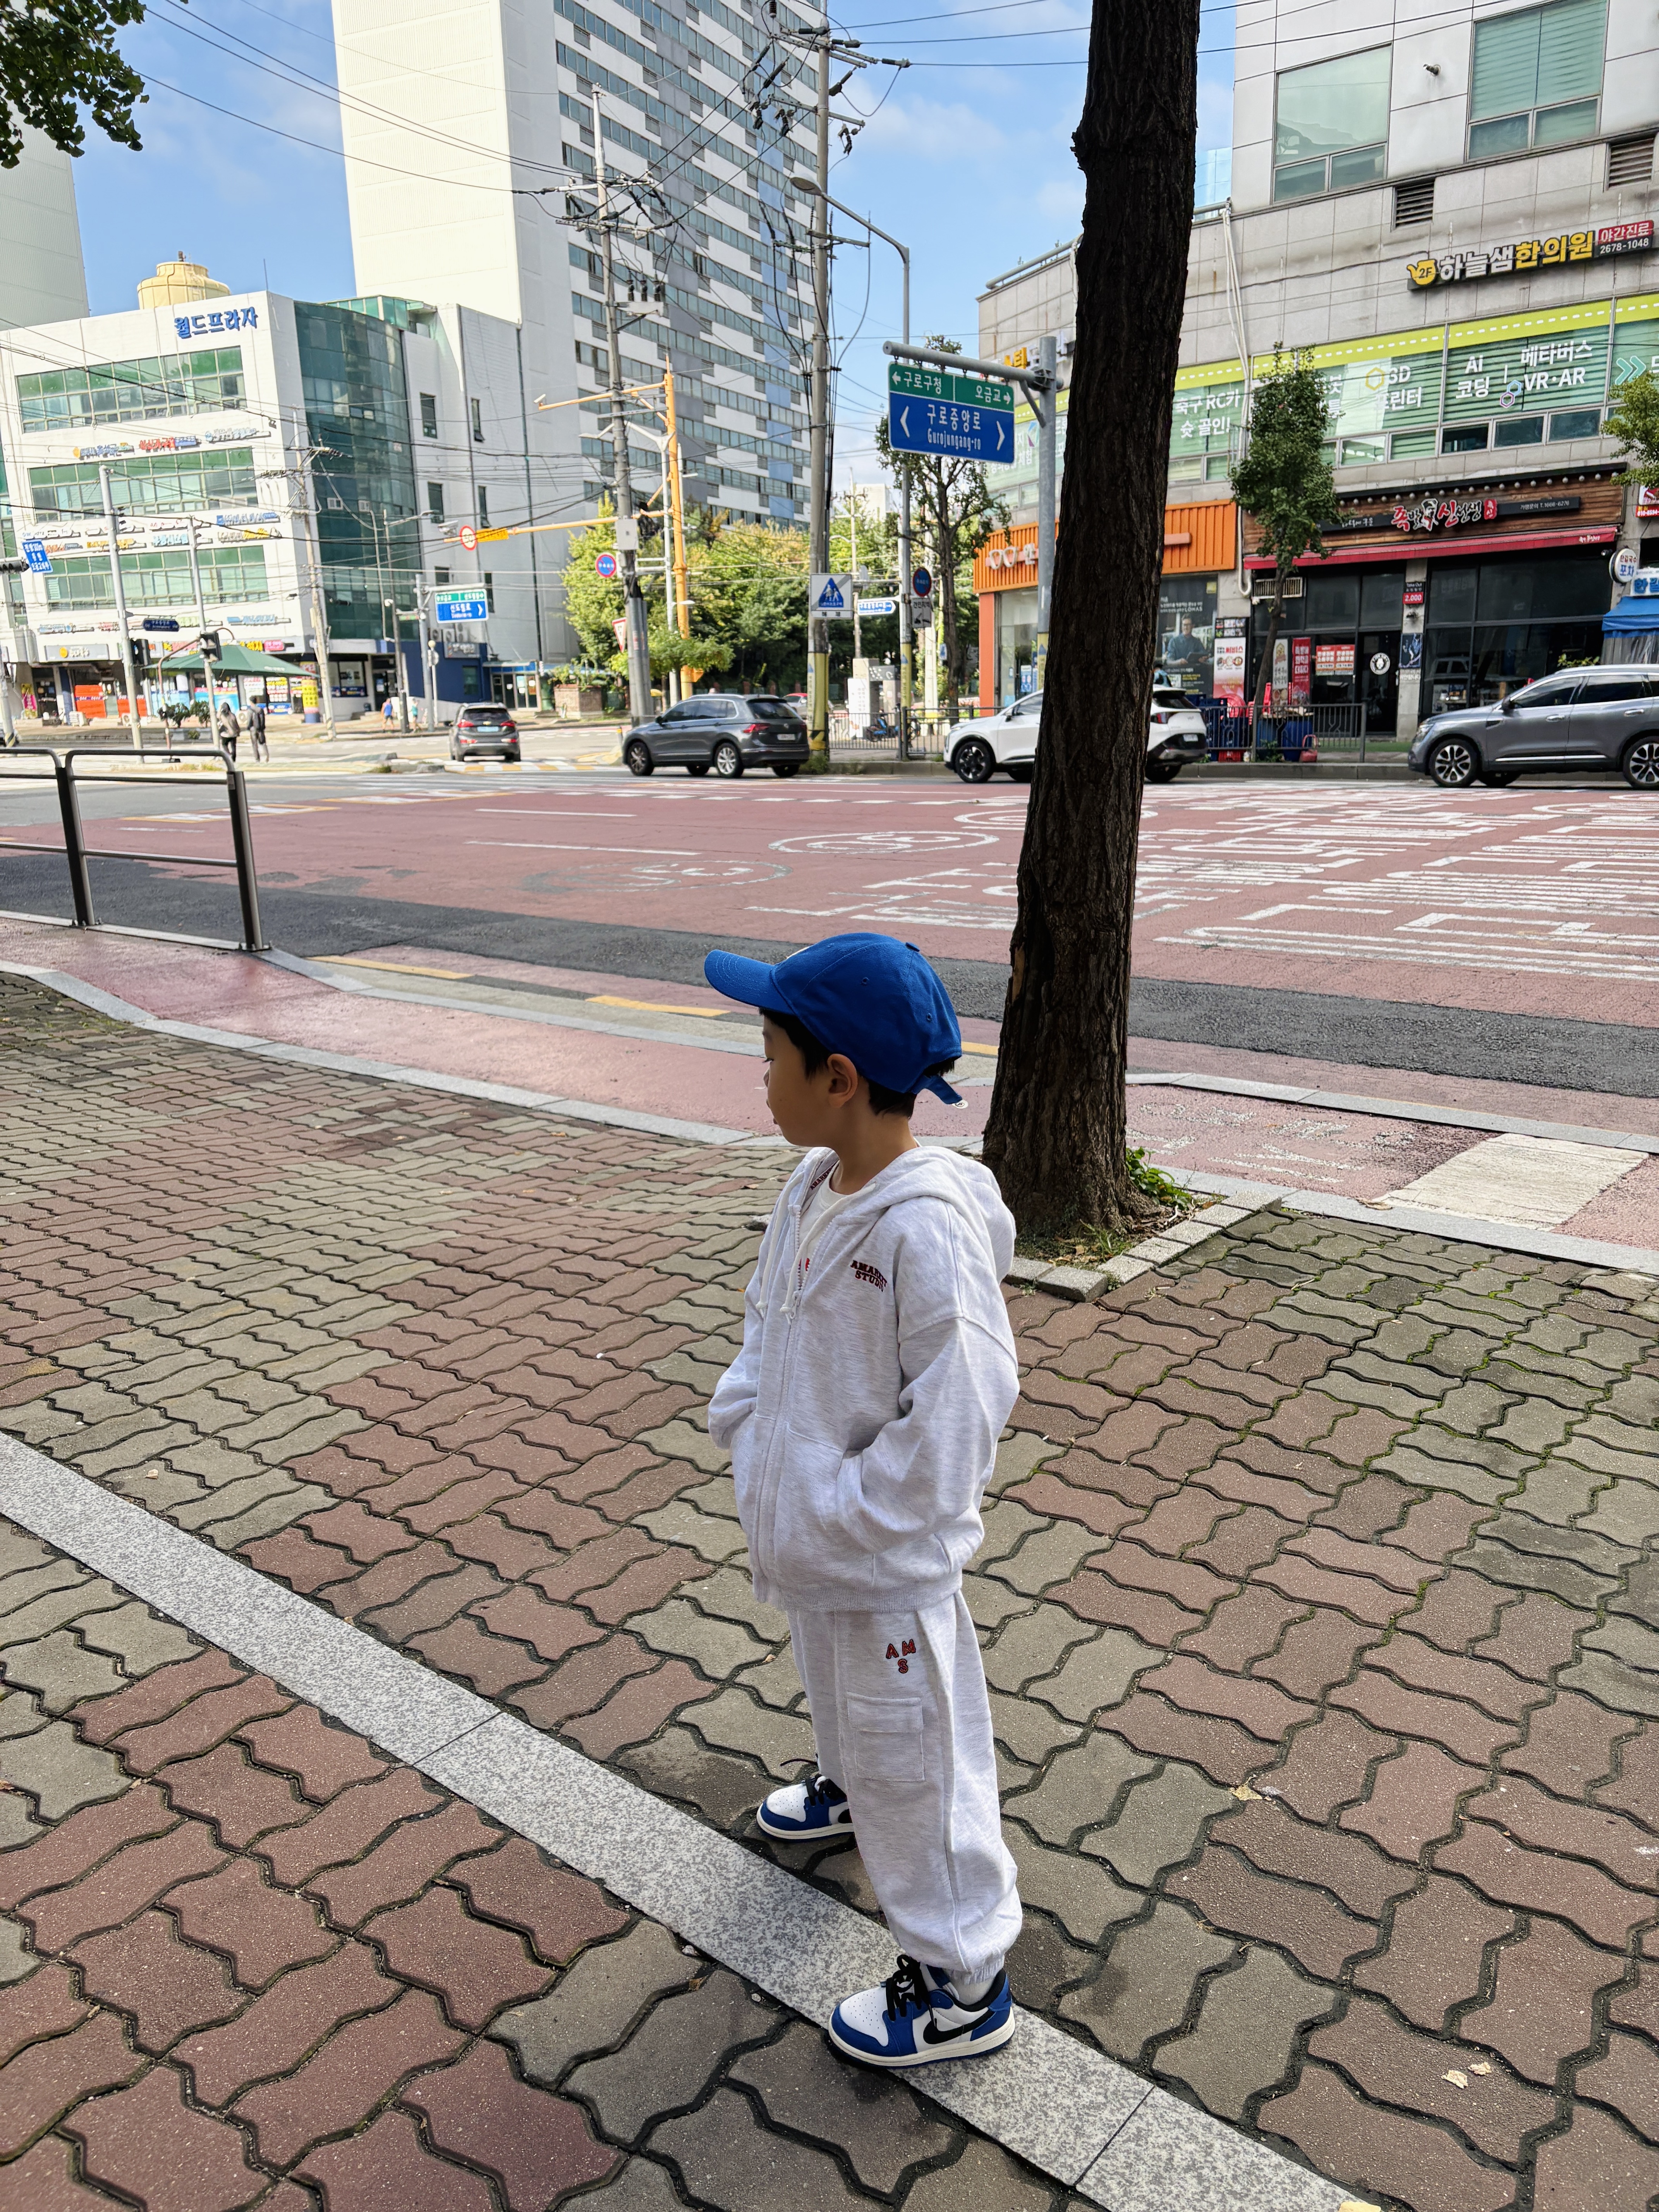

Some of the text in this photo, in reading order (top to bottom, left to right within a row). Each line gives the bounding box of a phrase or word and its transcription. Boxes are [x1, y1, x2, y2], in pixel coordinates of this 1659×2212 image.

[1601, 223, 1649, 242] 야간진료
[1419, 231, 1593, 280] 2F 하늘샘한의원
[1600, 237, 1649, 254] 2678-1048
[174, 307, 258, 339] 월드프라자
[1521, 340, 1592, 366] 메타버스
[904, 372, 941, 395] 구로구청
[1389, 366, 1411, 384] 3D
[975, 386, 1001, 403] 오금교
[1376, 387, 1422, 410] 프린터
[1456, 377, 1489, 399] 코딩
[1175, 389, 1241, 414] 축구 RC카
[927, 404, 981, 433] 구로중앙로
[1198, 416, 1230, 436] 골인!
[927, 428, 981, 452] Gurojungang-ro
[1620, 555, 1637, 563] 한길국수
[1620, 565, 1634, 577] 포차
[898, 1659, 908, 1674] S
